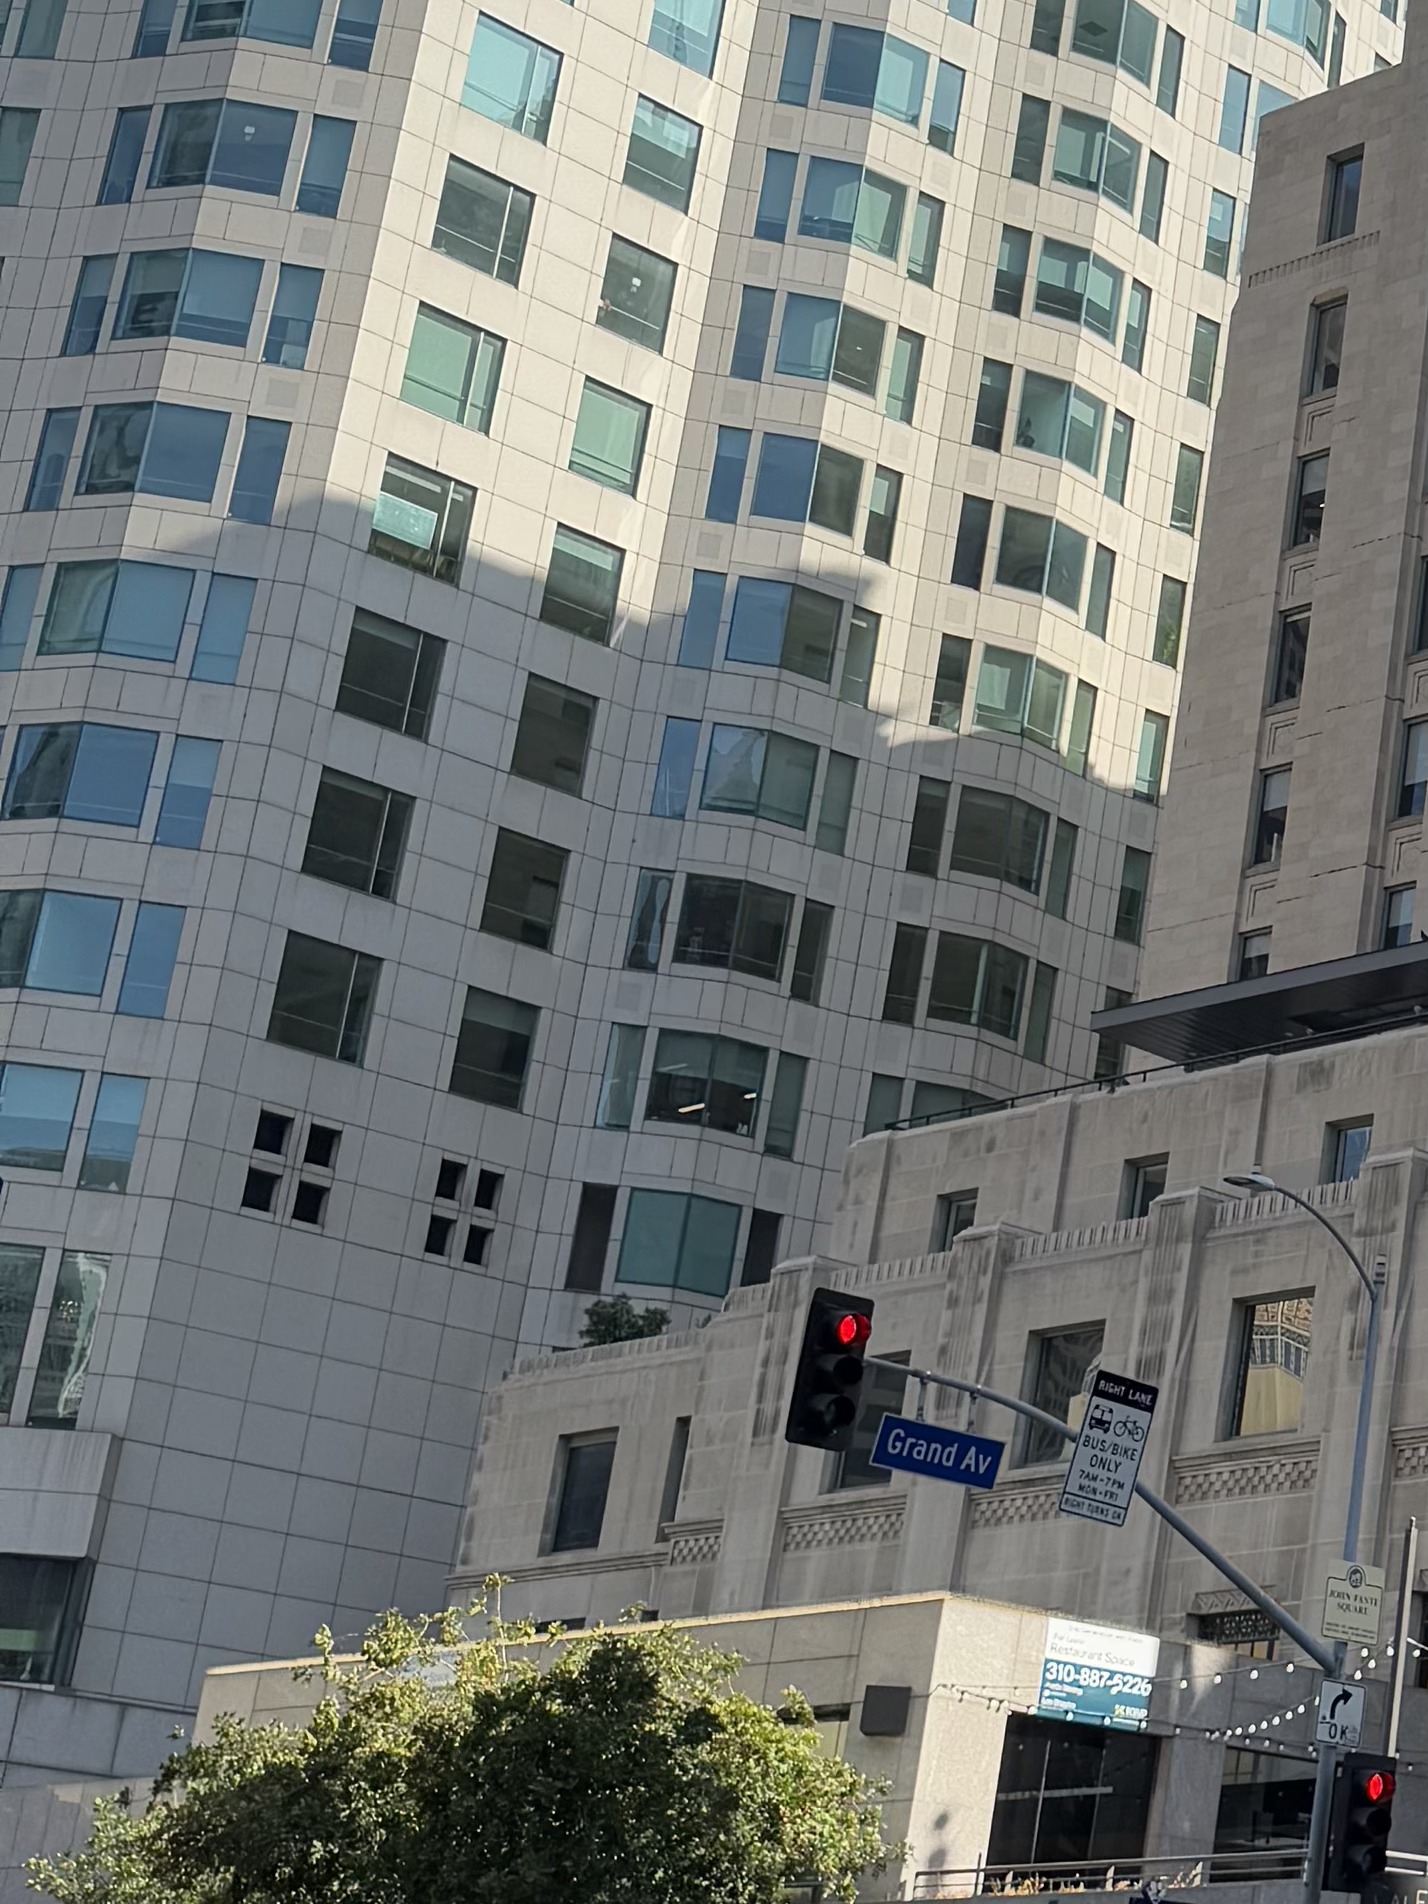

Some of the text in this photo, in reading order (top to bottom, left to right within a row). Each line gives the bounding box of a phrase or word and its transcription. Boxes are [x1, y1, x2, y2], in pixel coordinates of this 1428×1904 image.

[1098, 1380, 1153, 1406] RIGHT LANE
[887, 1428, 992, 1475] Grand Av
[1082, 1435, 1139, 1461] BUS/BIKE
[1090, 1454, 1122, 1474] ONLY
